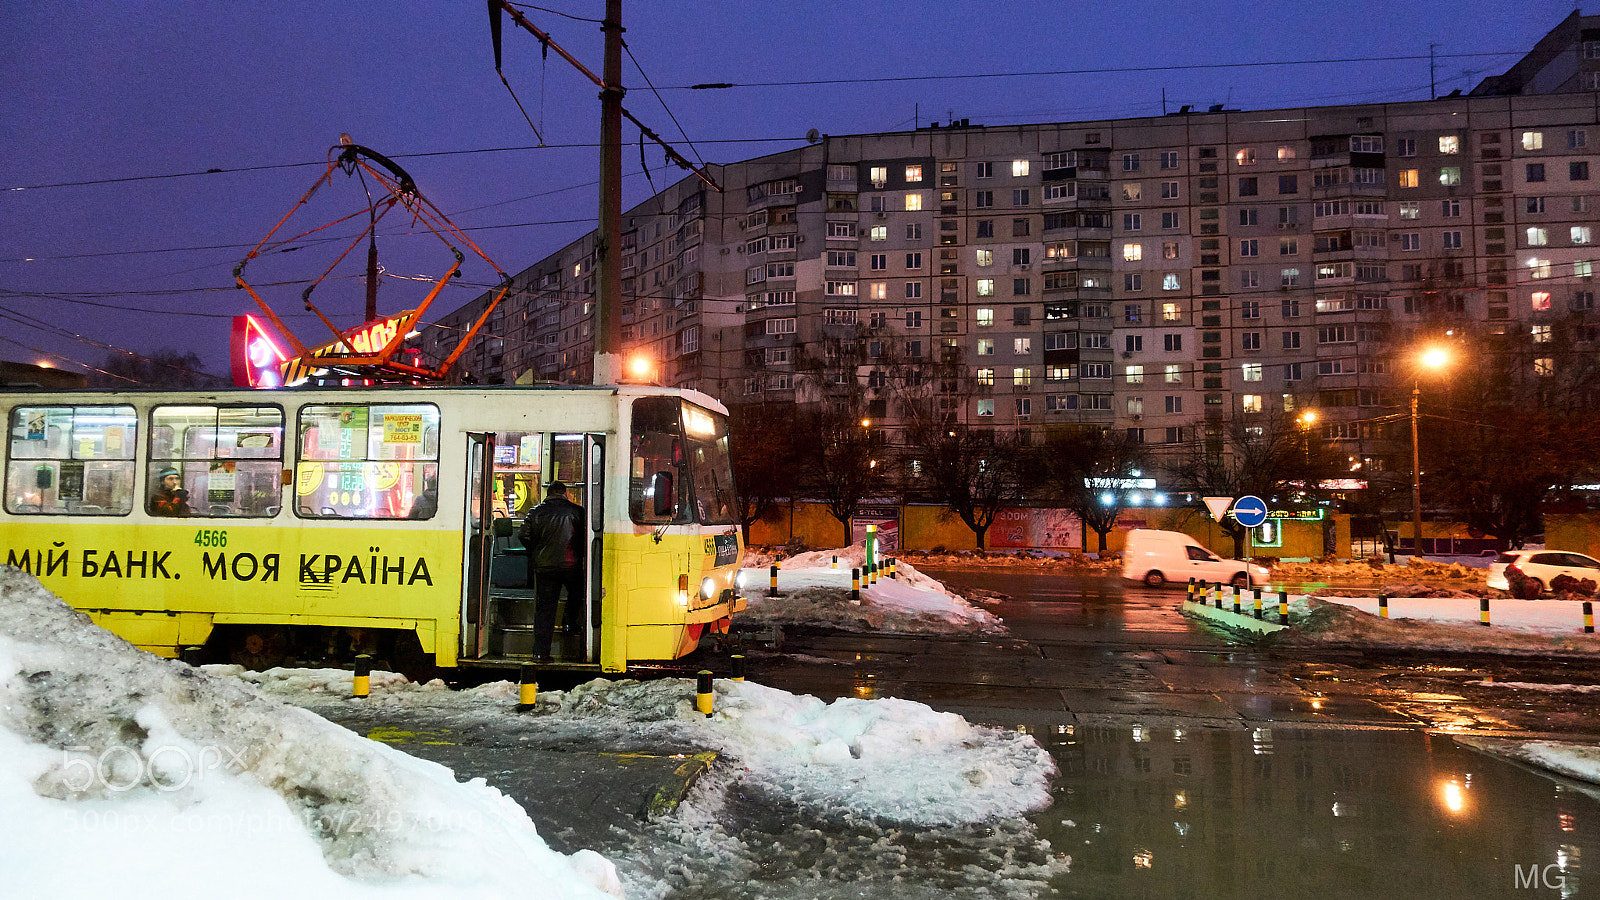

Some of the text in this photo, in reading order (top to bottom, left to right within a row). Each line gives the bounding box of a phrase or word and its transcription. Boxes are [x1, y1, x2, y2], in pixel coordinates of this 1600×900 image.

[194, 530, 228, 548] 4566
[8, 541, 434, 587] МІЙ БАНК. МОЯ КРАЇНА
